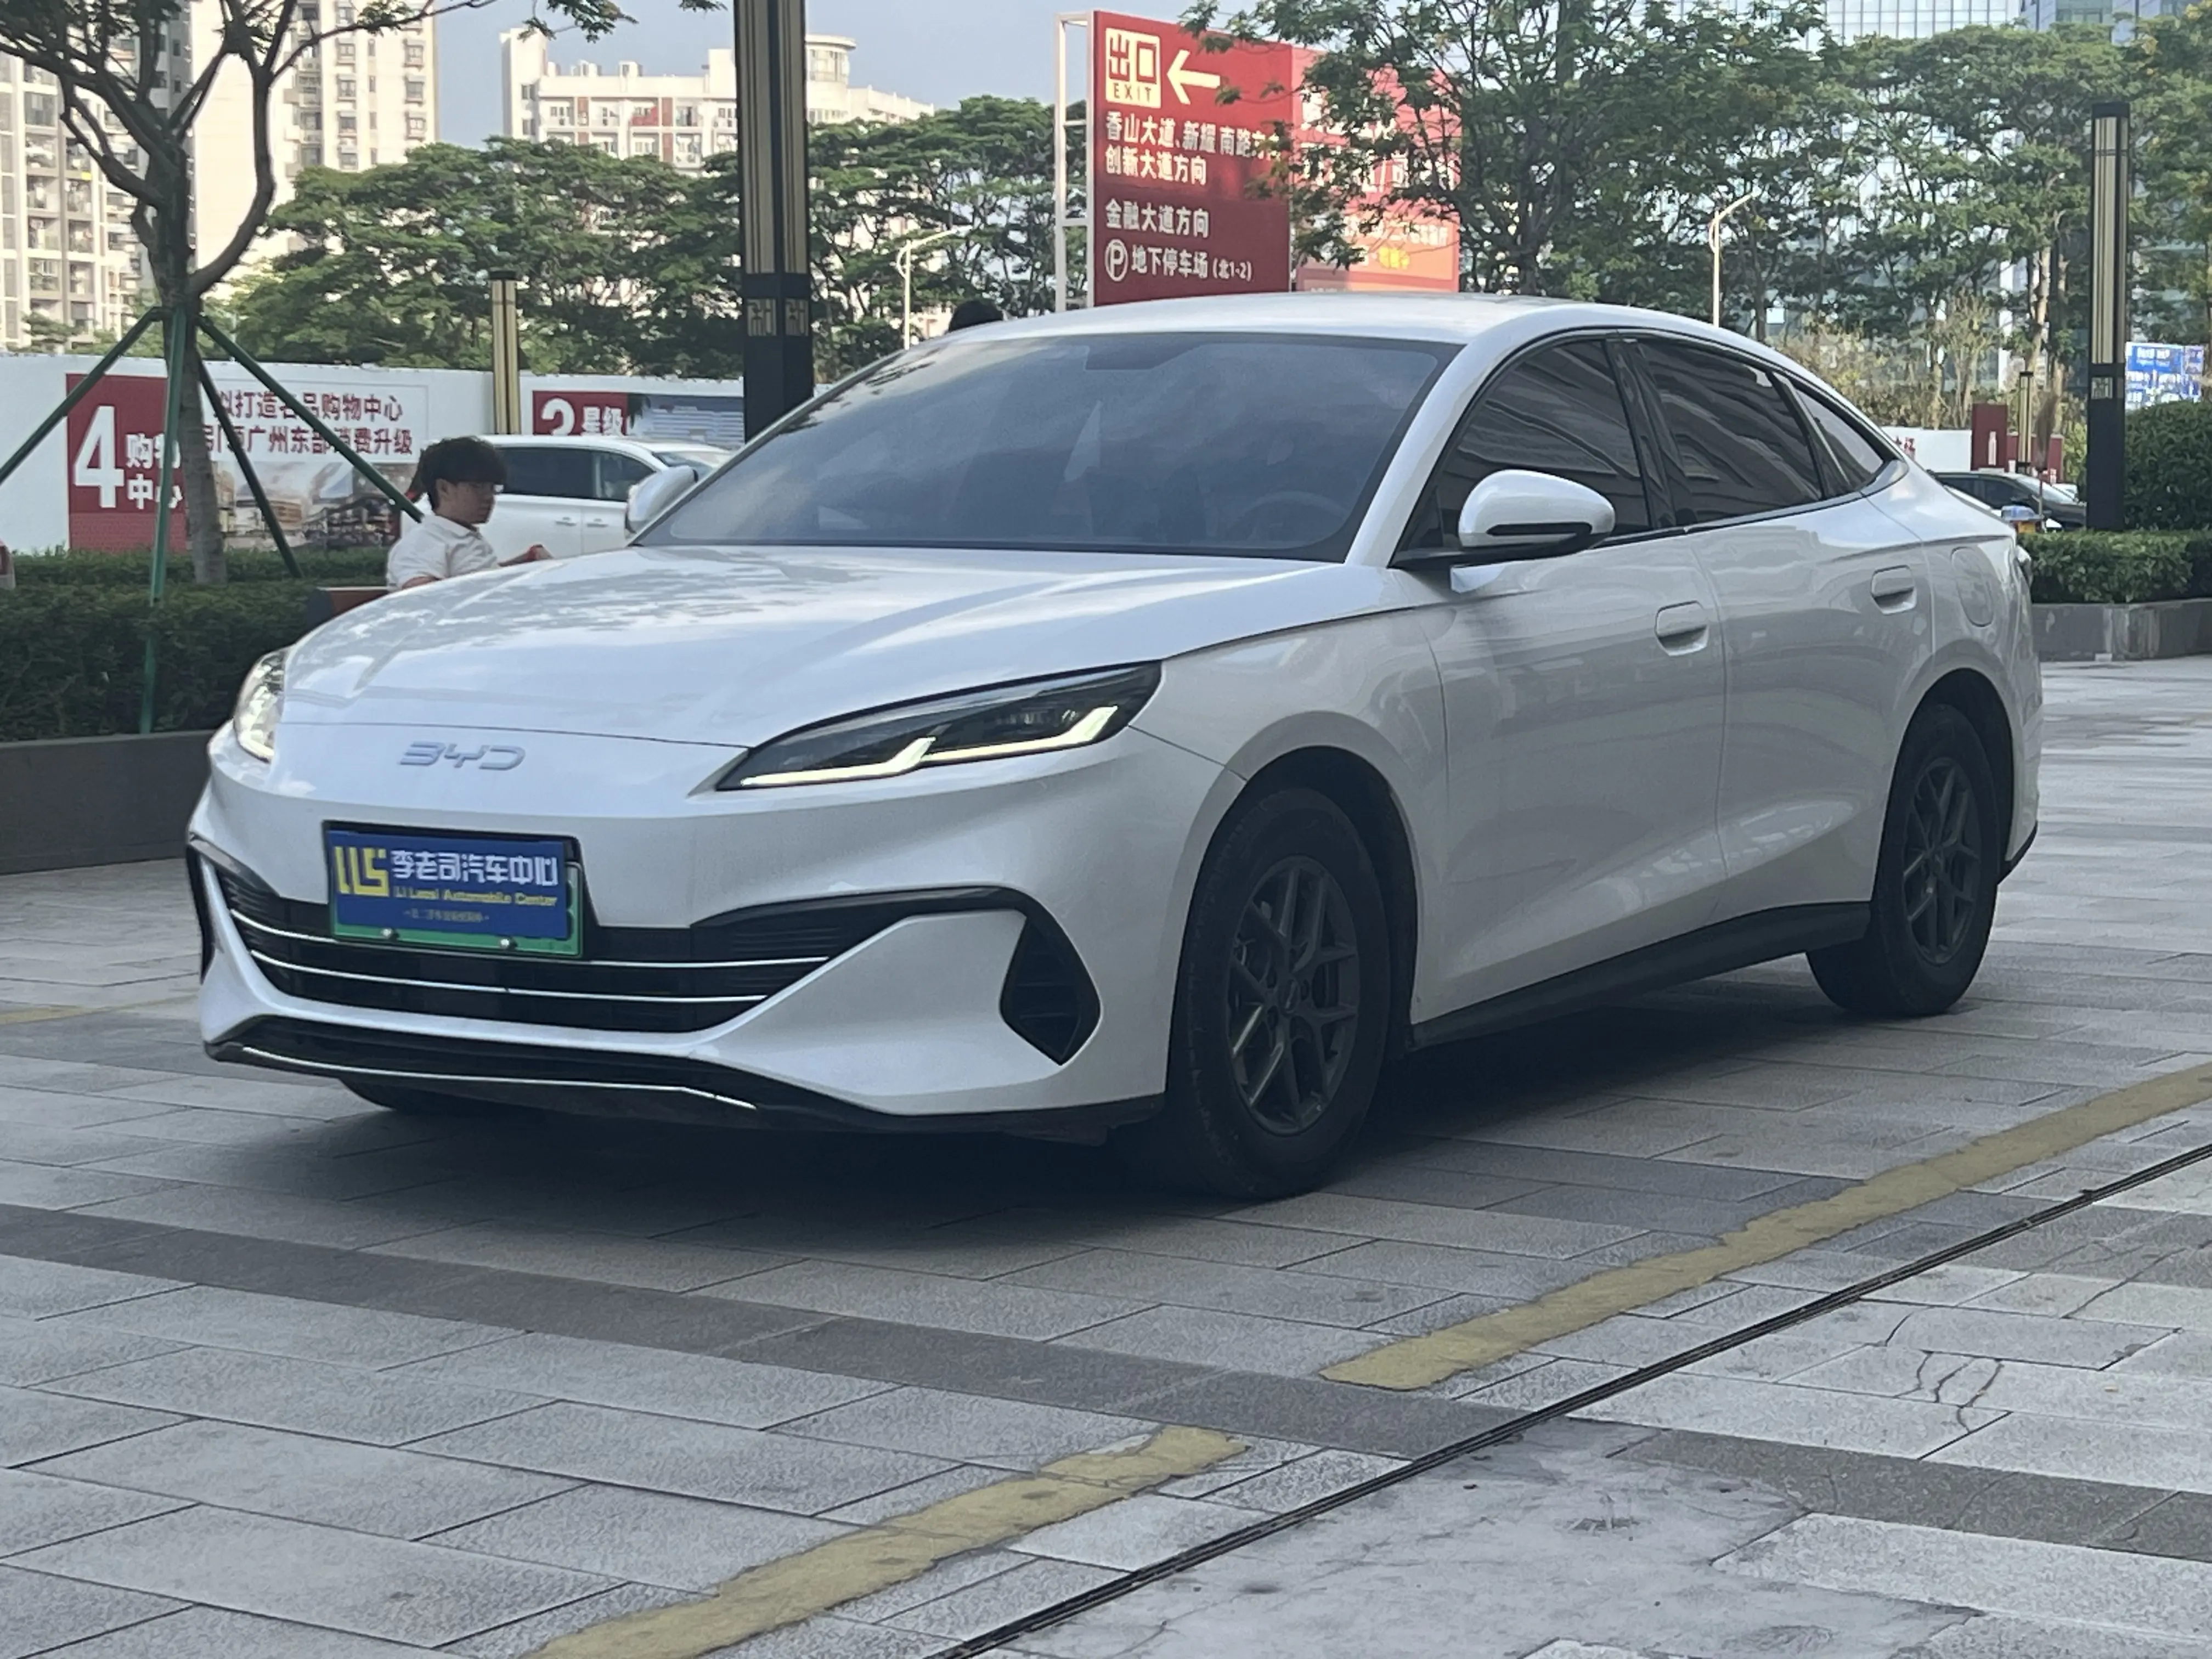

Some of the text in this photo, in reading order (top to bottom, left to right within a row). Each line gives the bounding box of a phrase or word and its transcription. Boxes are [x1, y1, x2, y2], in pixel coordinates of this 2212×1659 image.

[1109, 34, 1157, 84] 出口
[1113, 83, 1152, 103] EXIT
[1105, 144, 1206, 185] 创新大道方向
[1105, 198, 1209, 238] 金融大道方向
[1132, 245, 1208, 278] 地下停车场
[75, 405, 125, 508] 4
[398, 740, 526, 771] BYD
[391, 850, 558, 886] 李老司汽车中心
